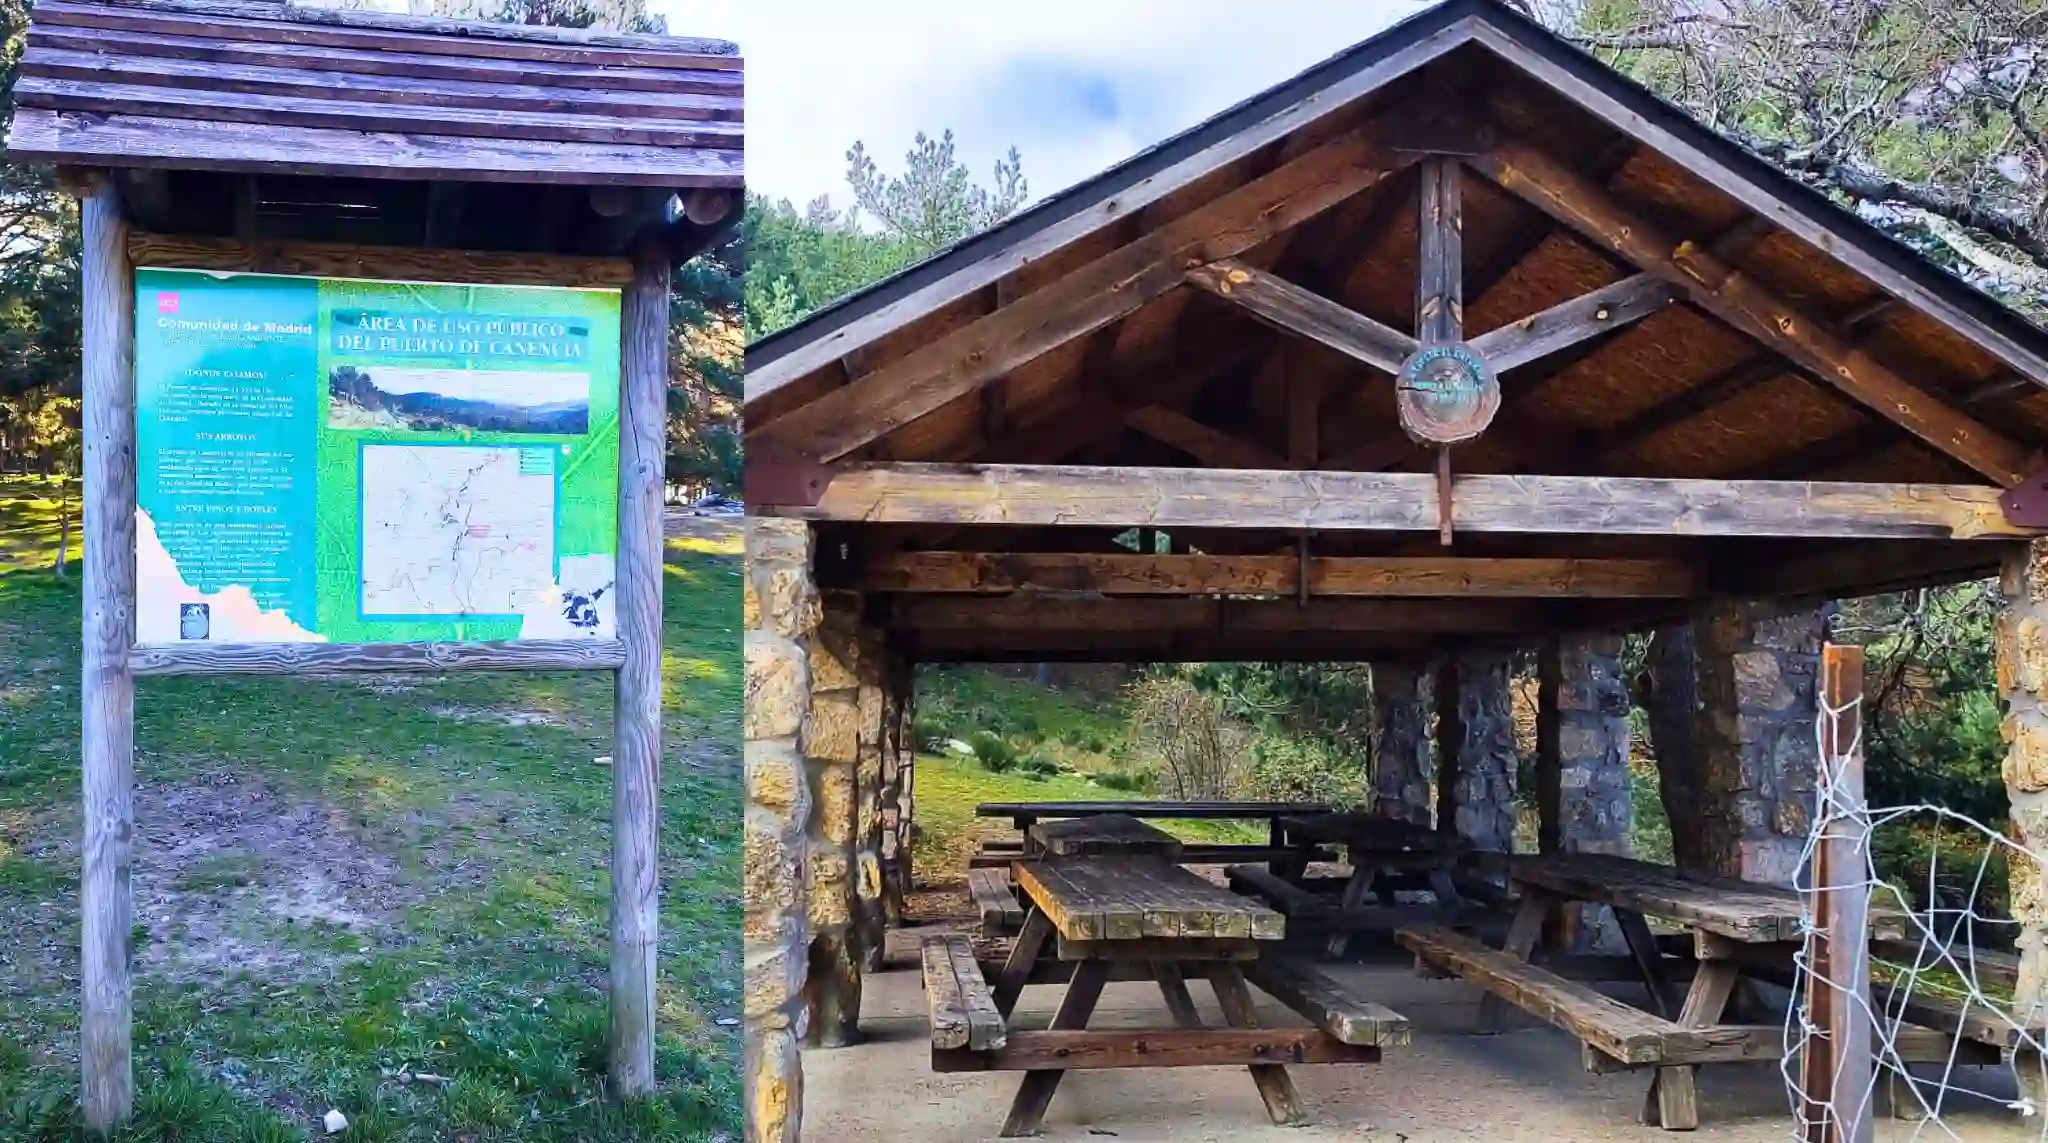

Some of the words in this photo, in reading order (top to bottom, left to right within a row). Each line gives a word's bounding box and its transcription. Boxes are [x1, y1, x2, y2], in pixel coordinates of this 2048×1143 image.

[157, 317, 239, 332] Comunidad
[243, 321, 261, 333] de
[264, 322, 313, 336] Madrid
[356, 312, 407, 333] ÁREA
[412, 317, 437, 334] DE
[443, 319, 482, 335] USO
[486, 318, 565, 338] PÚBLICO
[338, 334, 374, 352] DEL
[379, 335, 454, 354] PUERTO
[459, 340, 483, 355] DE
[489, 340, 582, 358] CANENCIA
